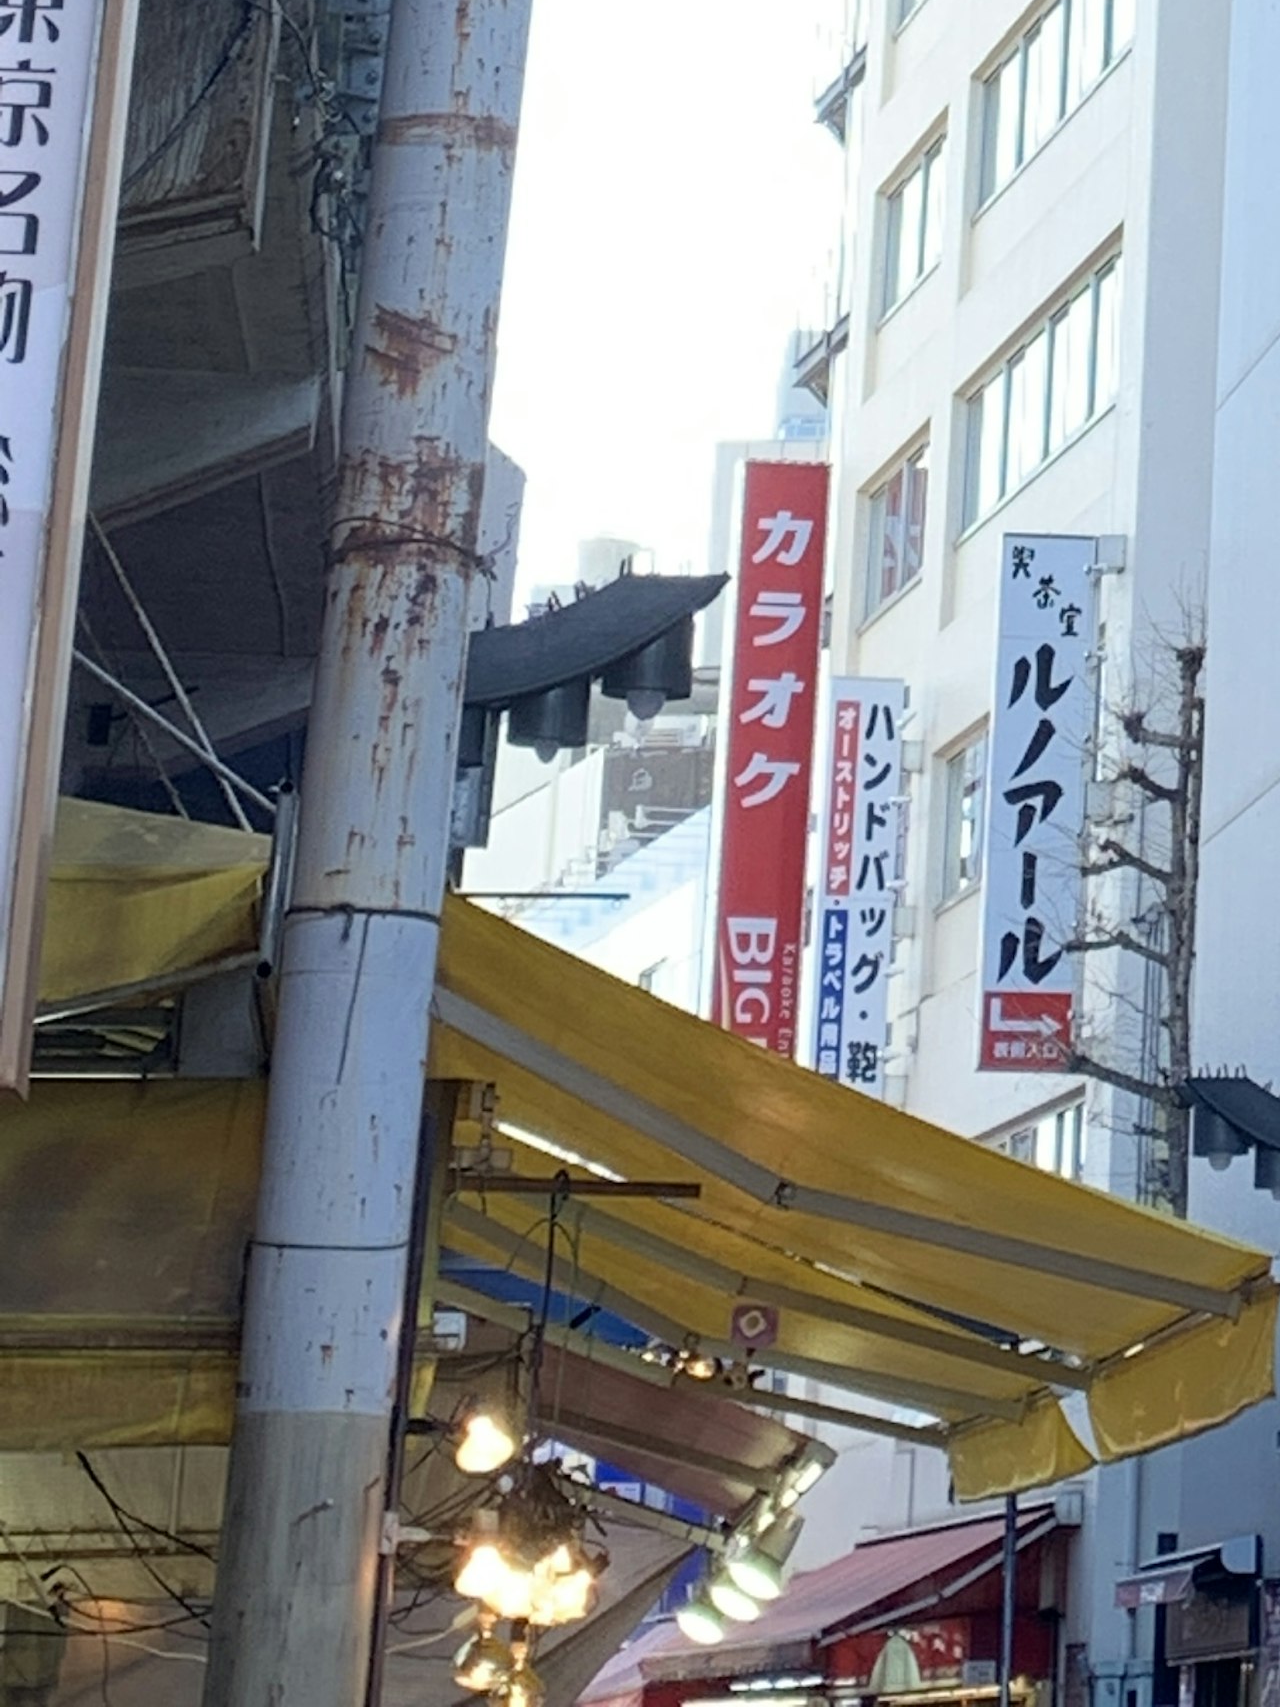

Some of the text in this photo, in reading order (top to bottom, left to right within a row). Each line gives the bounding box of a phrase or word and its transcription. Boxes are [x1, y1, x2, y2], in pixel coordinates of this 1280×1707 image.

[734, 509, 814, 808] カラオケ
[996, 642, 1074, 986] ルノアール
[726, 917, 778, 1025] BIG
[846, 702, 896, 1084] ハンドバッグ・鞄
